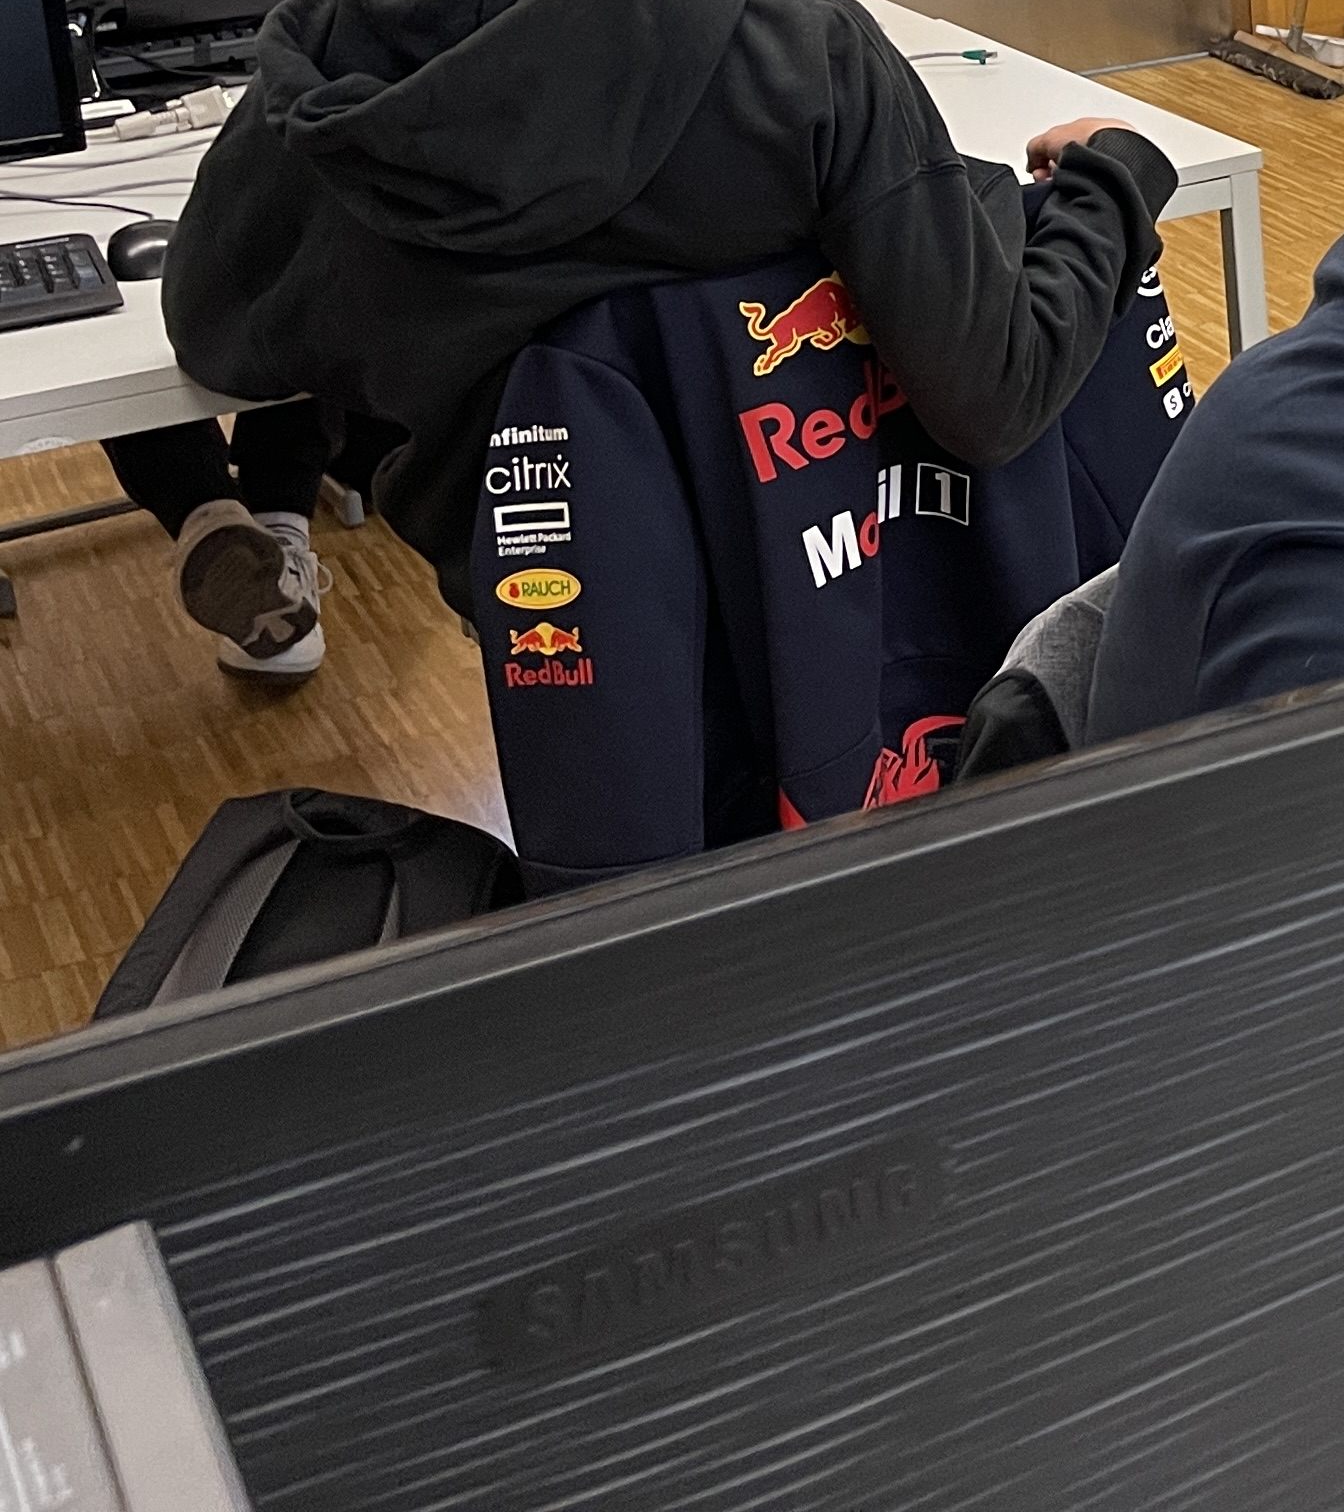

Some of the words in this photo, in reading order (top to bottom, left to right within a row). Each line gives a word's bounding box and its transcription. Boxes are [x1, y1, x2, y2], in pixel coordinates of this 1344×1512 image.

[1145, 314, 1176, 350] Cla
[488, 424, 569, 448] nfinitum
[485, 453, 572, 495] citrix
[801, 463, 903, 589] Moil
[934, 471, 952, 515] 1
[521, 580, 571, 597] RAUCH
[504, 657, 594, 688] RedBull
